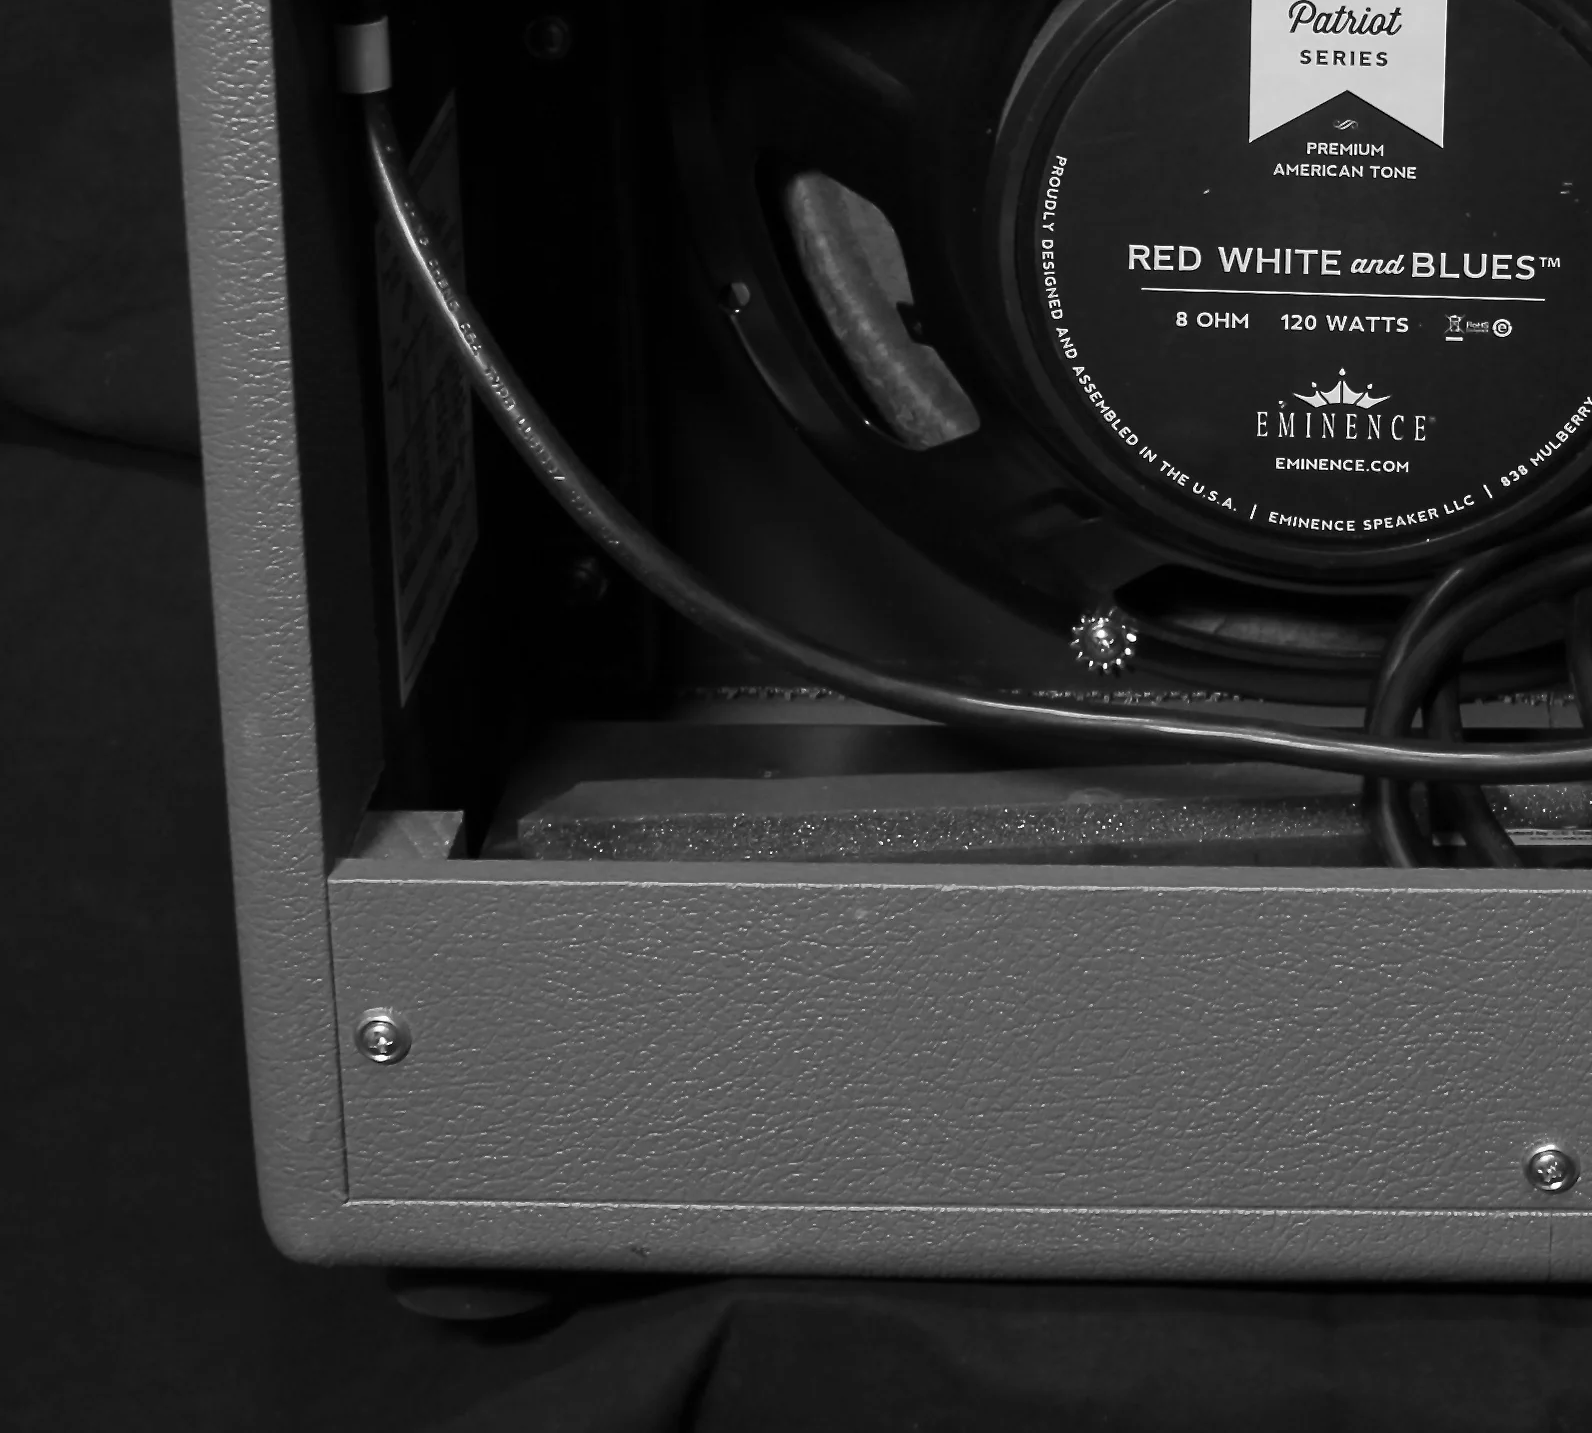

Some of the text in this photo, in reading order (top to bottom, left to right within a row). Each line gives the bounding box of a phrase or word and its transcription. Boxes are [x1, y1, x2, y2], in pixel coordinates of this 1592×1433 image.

[1298, 48, 1391, 68] SERIES
[1306, 141, 1385, 157] PREMIUM
[1272, 162, 1417, 180] AMERICAN TONE
[1041, 155, 1068, 232] PROUDLY
[1128, 243, 1202, 272] RED
[1217, 246, 1342, 276] WHITE
[1350, 254, 1405, 275] and
[1041, 239, 1064, 320] DESIGNED
[1175, 311, 1409, 333] 8 OHM 120 WATTS
[1055, 327, 1078, 359] AND
[1071, 366, 1139, 446] ASSEMBLED
[1256, 411, 1426, 442] EMINENCE
[1138, 445, 1158, 463] IN
[1275, 457, 1410, 473] EMINENCE.COM
[1159, 460, 1190, 487] THE
[1500, 464, 1529, 487] 838
[1192, 481, 1237, 512] U.S.A.
[1443, 494, 1475, 515] LLC
[1268, 511, 1356, 532] EMINENCE
[1362, 507, 1440, 531] SPEAKER
